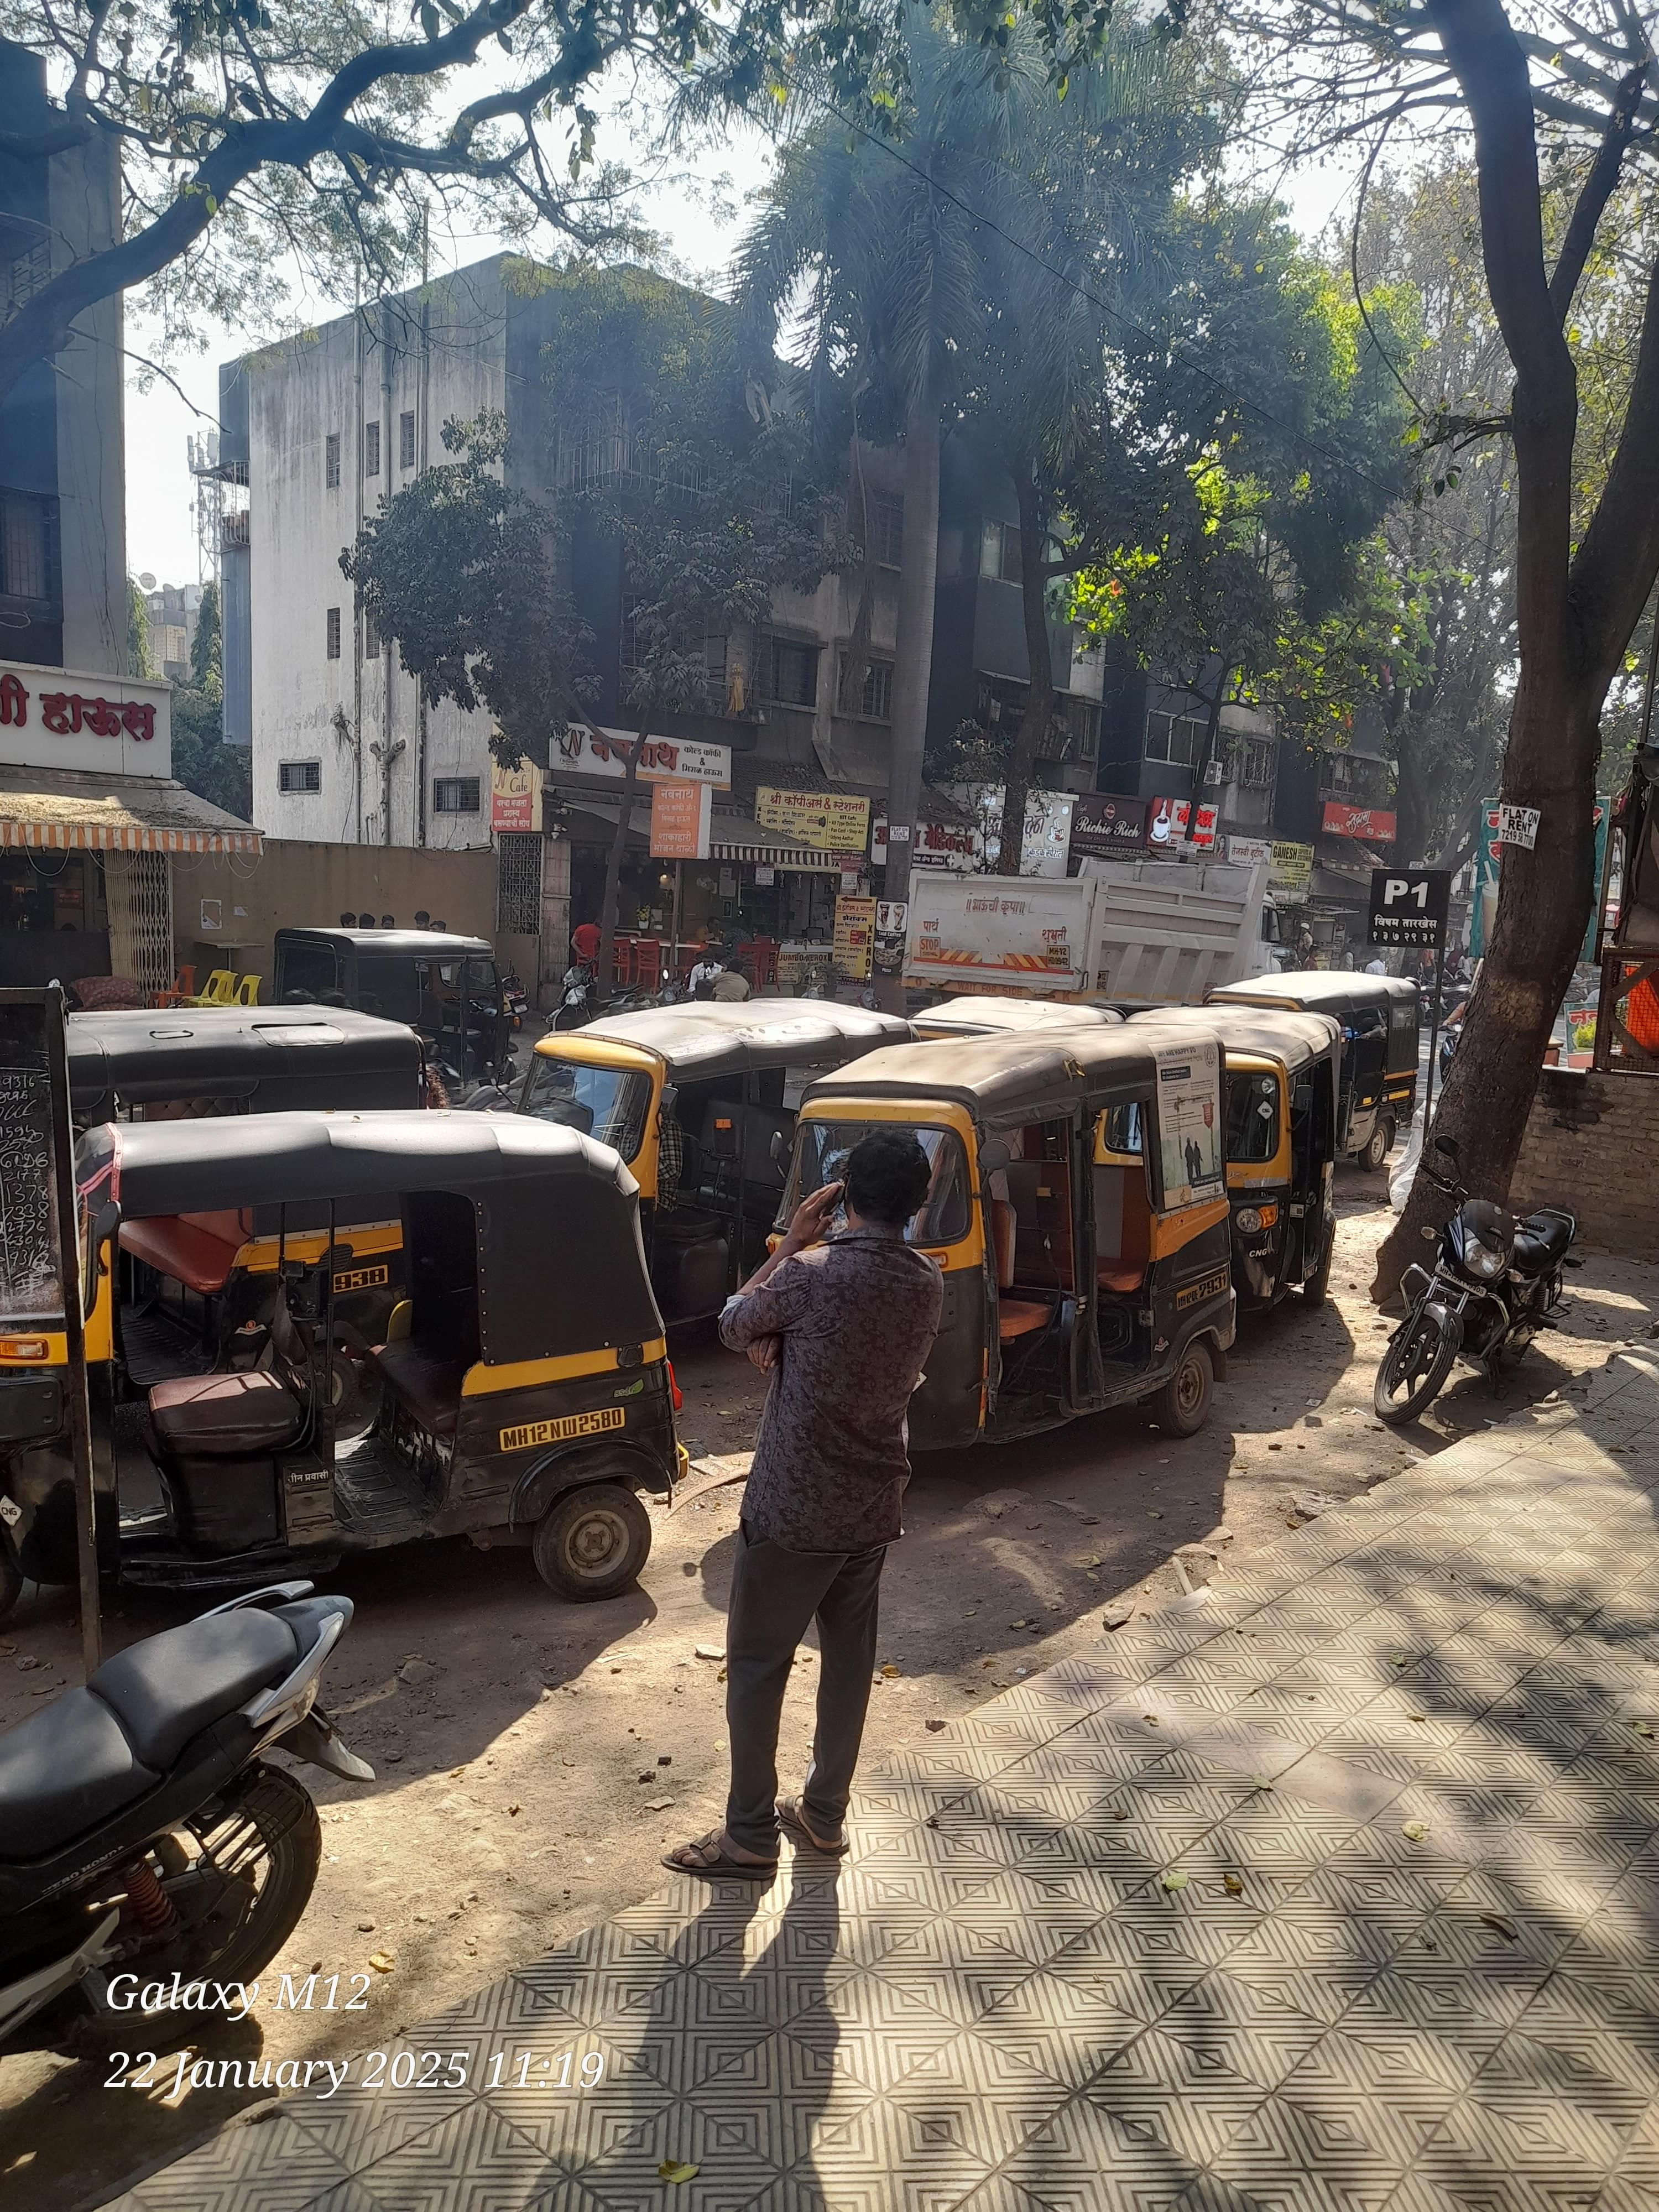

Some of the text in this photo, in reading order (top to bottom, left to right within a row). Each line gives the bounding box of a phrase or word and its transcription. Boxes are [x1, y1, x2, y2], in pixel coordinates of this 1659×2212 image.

[39, 692, 156, 741] हाऊस
[684, 744, 721, 758] कोल्ड कॉफी
[700, 758, 706, 766] &
[661, 789, 694, 800] नवनाथ
[770, 792, 864, 813] श्री कॉपीअर्स & स्टेशनरी
[1503, 807, 1527, 820] FLAT
[1528, 811, 1538, 825] ON
[1076, 816, 1141, 838] Richie Rich
[1508, 819, 1532, 834] RENT
[659, 831, 691, 843] शाकाहारी
[1501, 830, 1517, 841] 7219
[1029, 848, 1045, 857] कडक
[1232, 844, 1249, 857] तेजस्वी
[1274, 846, 1297, 860] GANESH
[1384, 879, 1429, 907] P1
[924, 918, 939, 931] पार्थ
[1374, 914, 1438, 928] विषम तारखेस
[1383, 932, 1389, 941] ३
[1392, 932, 1400, 941] ७
[920, 938, 939, 951] STOP
[958, 982, 976, 990] WAIT
[982, 985, 995, 993] FOR
[1002, 988, 1022, 996] SIDE
[7, 1183, 49, 1203] 1378
[1249, 1248, 1268, 1258] CNG
[335, 1268, 385, 1290] 938
[1199, 1274, 1227, 1298] 7931
[305, 1469, 328, 1481] प्रवासी
